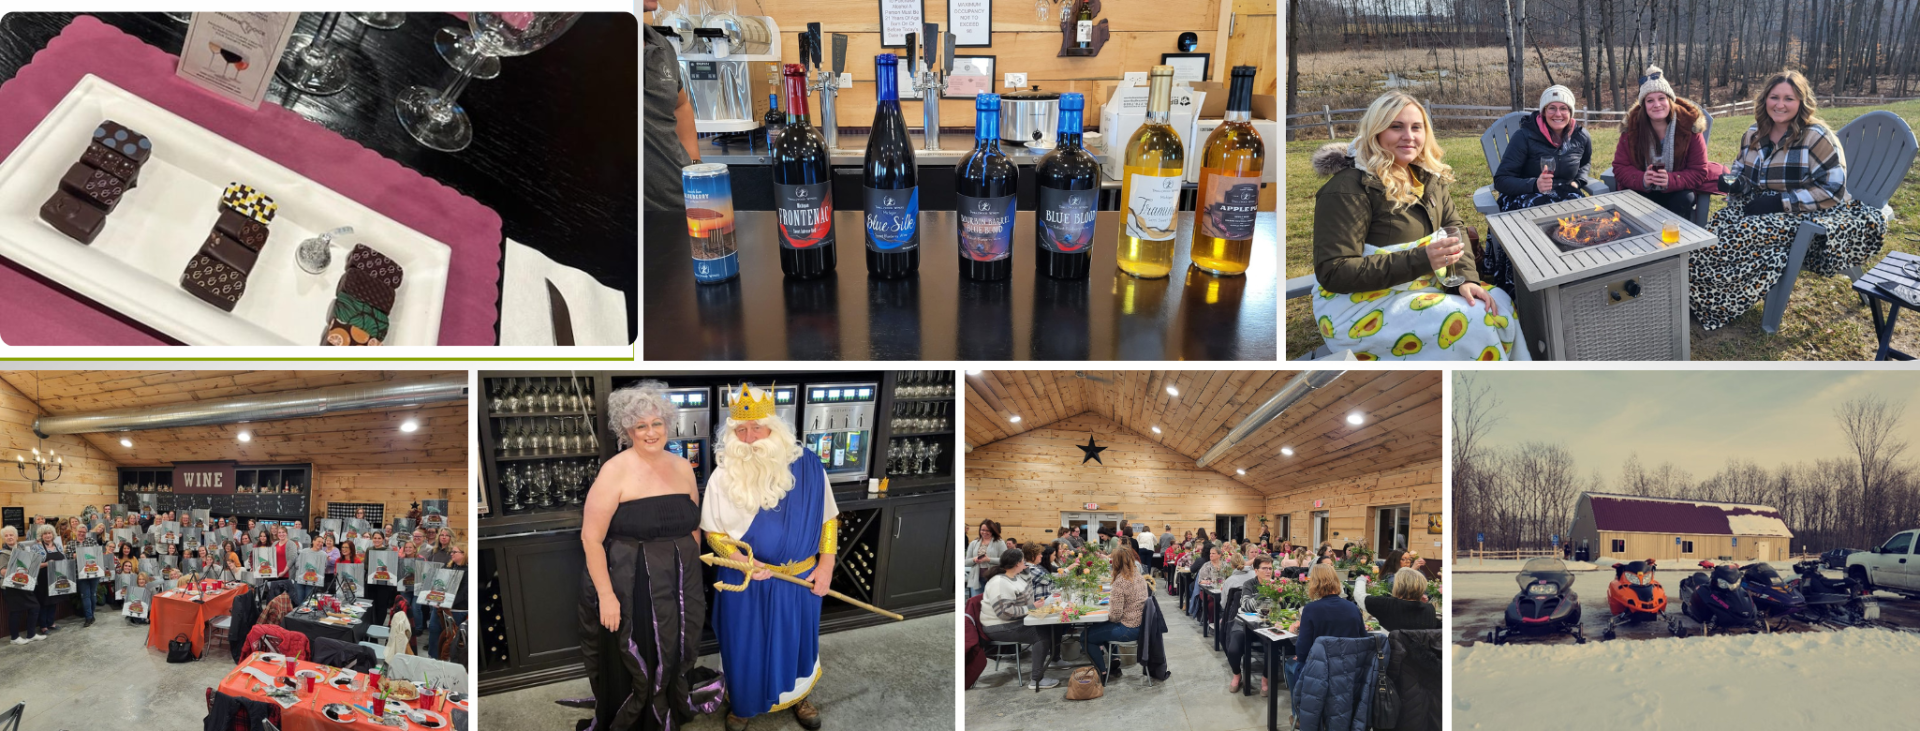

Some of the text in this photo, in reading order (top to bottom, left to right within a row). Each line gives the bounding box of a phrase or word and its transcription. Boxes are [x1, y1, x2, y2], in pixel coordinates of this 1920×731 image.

[778, 205, 829, 226] FRONTENAC
[867, 213, 915, 232] Blue Silk
[961, 214, 1010, 226] BOURBON BARREL
[1045, 209, 1071, 225] BLUE
[966, 224, 983, 234] BLUE
[183, 472, 223, 488] WINE
